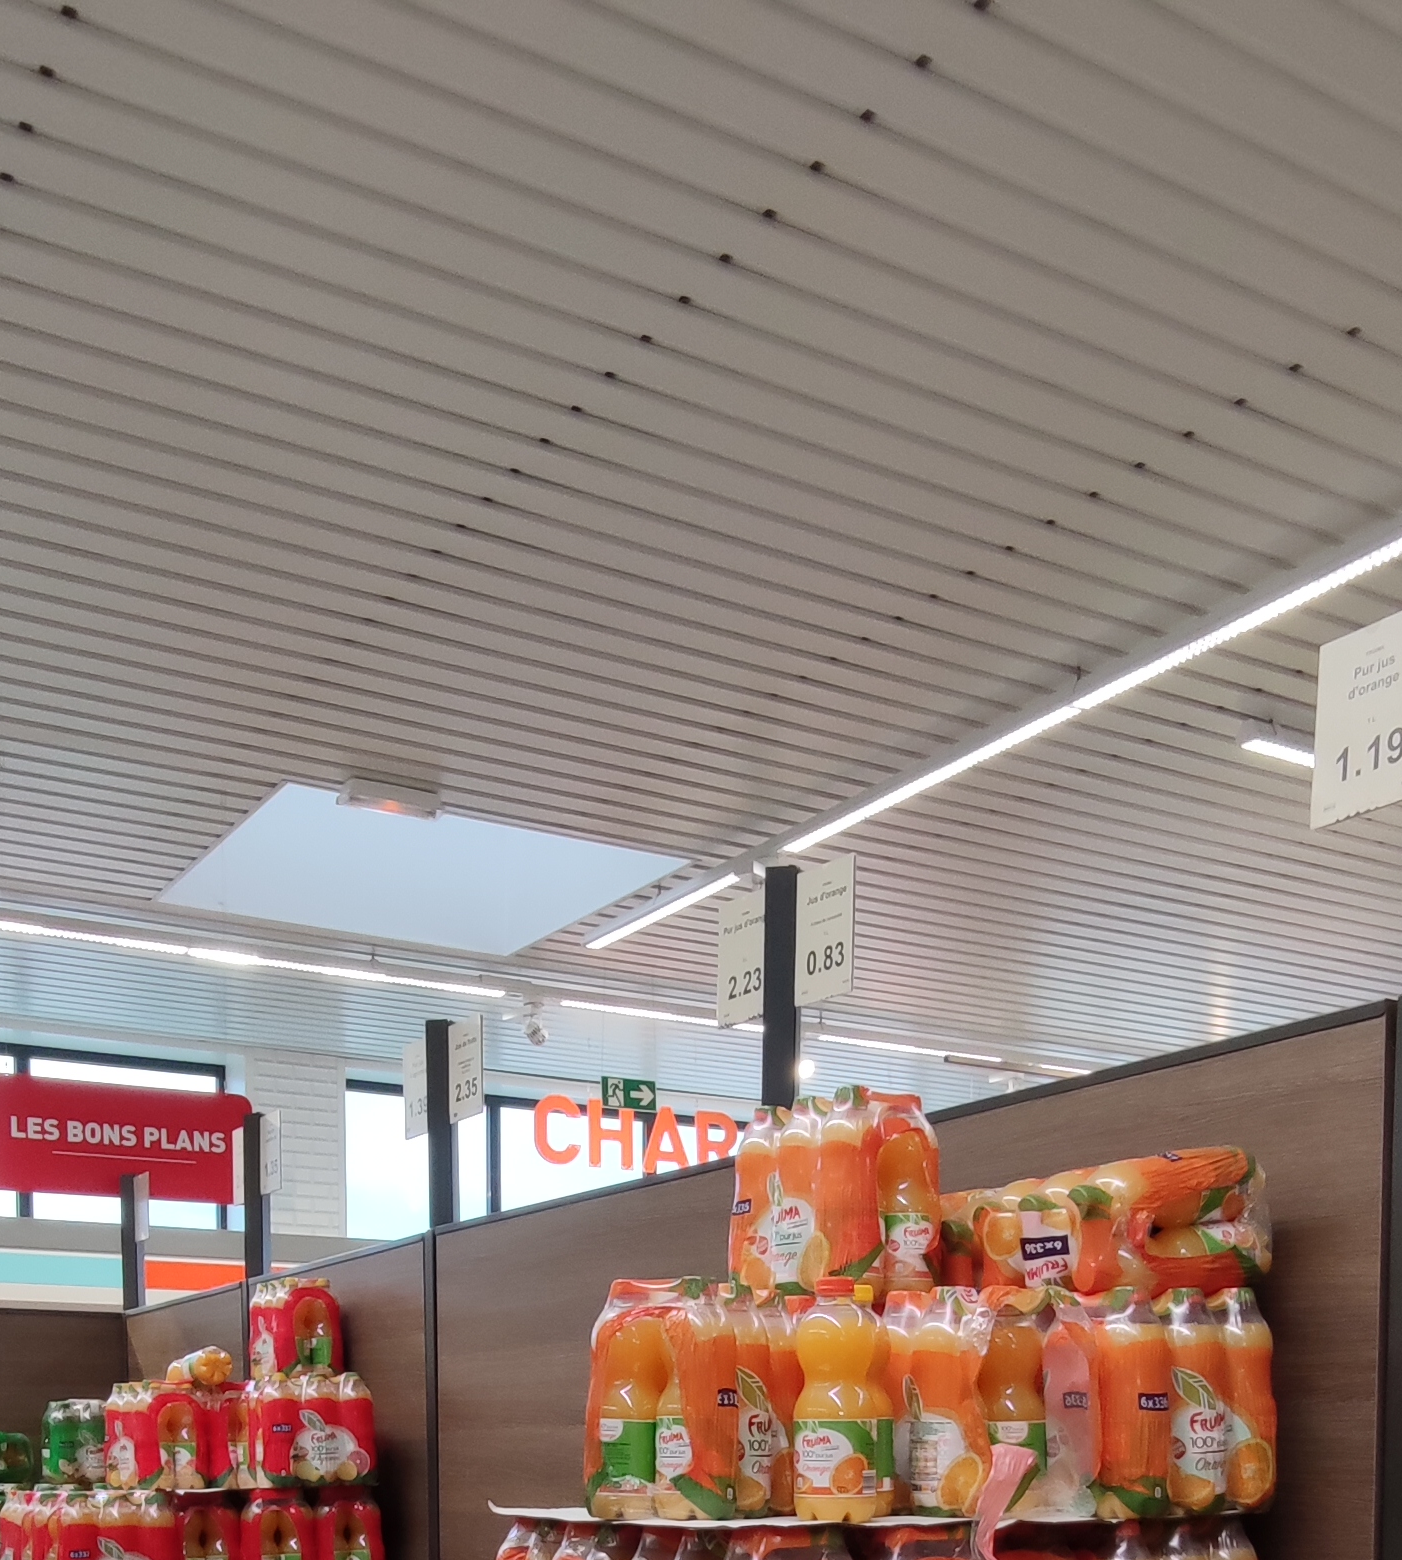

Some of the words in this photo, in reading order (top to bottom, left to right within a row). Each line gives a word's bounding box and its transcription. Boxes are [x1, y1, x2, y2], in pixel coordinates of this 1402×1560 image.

[1353, 664, 1374, 680] Pur
[1375, 654, 1396, 674] jus
[1347, 671, 1400, 701] d'orange
[806, 896, 818, 906] Jus
[819, 885, 848, 901] d'orange
[806, 941, 845, 976] 0.83
[728, 967, 762, 1000] 2.23
[455, 1077, 478, 1103] 2.35
[10, 1115, 60, 1141] LES
[67, 1120, 137, 1147] BONS
[144, 1127, 226, 1153] PLANS
[802, 1434, 832, 1448] FRUIMA
